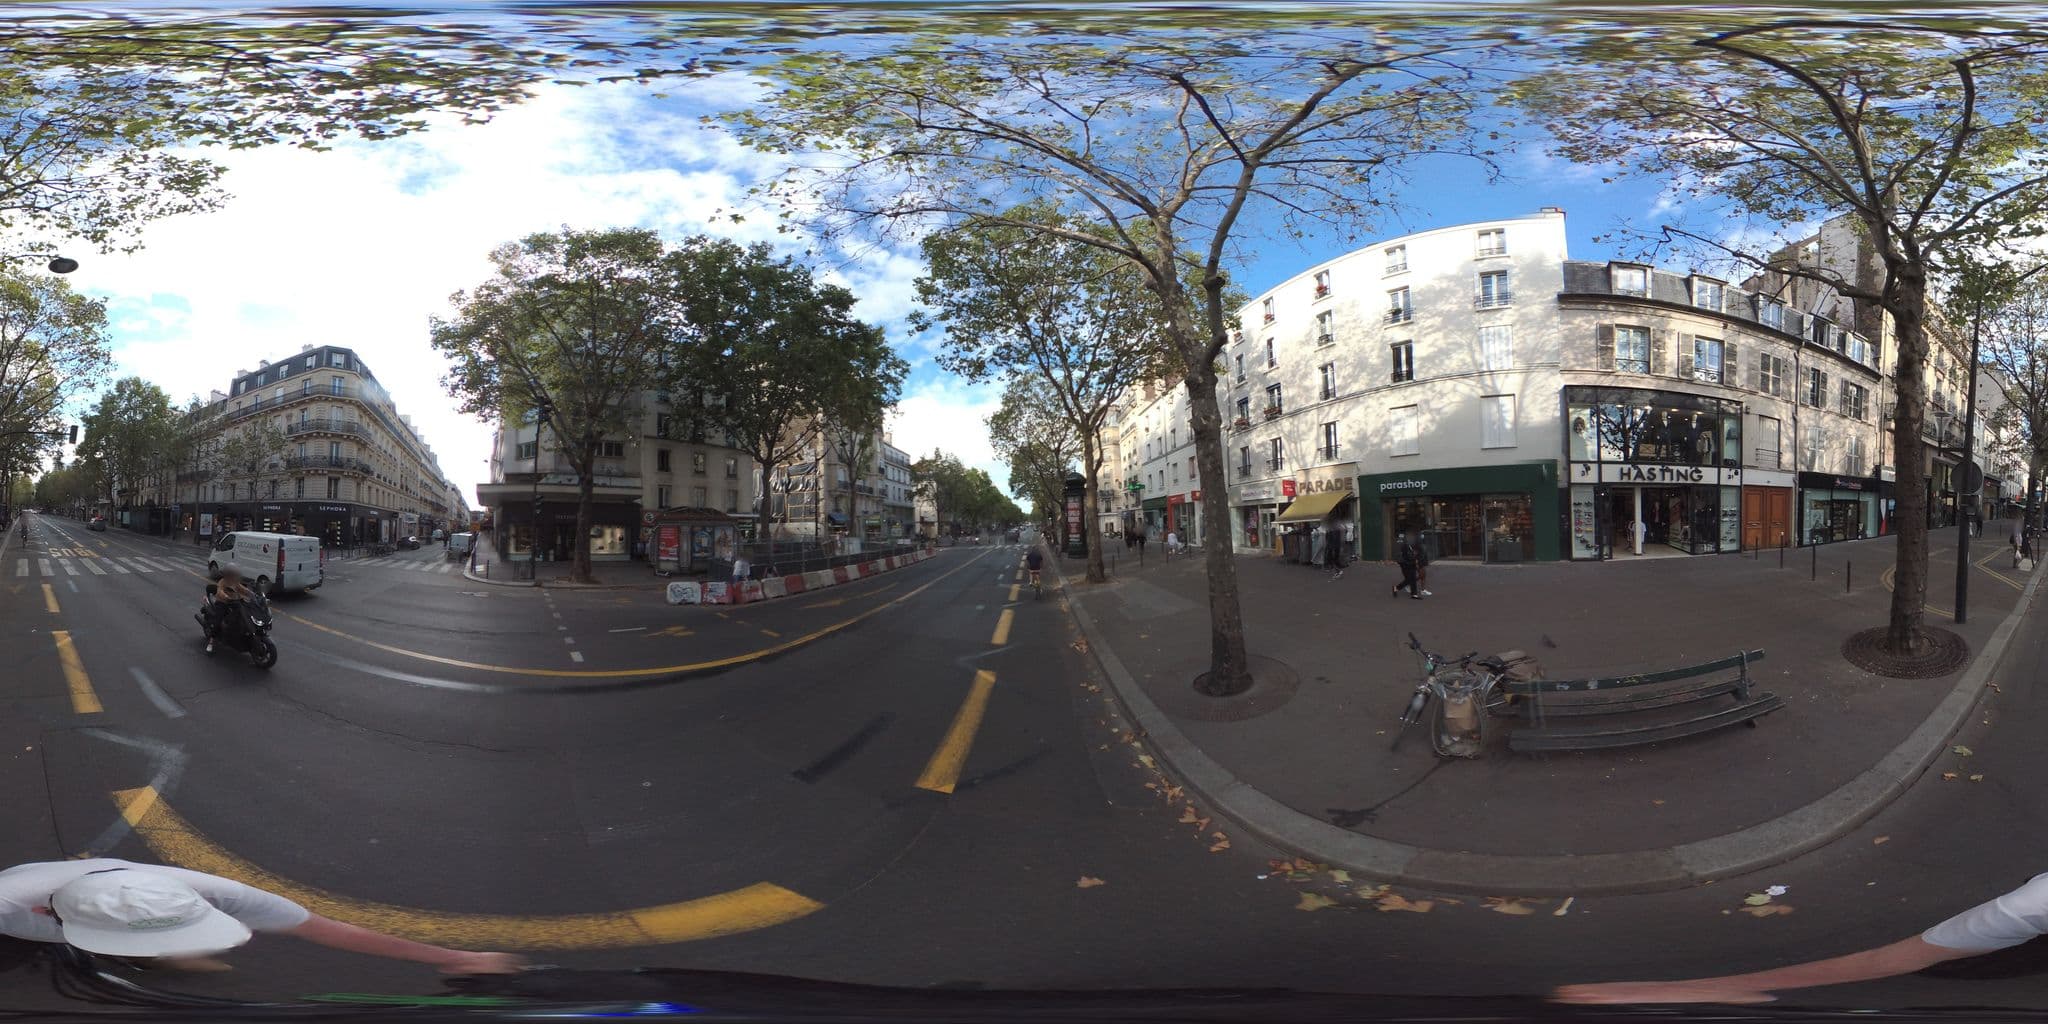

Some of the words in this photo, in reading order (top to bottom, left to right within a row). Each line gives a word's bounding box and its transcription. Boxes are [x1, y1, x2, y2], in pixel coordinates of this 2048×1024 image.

[1620, 466, 1704, 482] HASTING
[1299, 477, 1353, 494] PARADE
[1380, 479, 1428, 493] parashop
